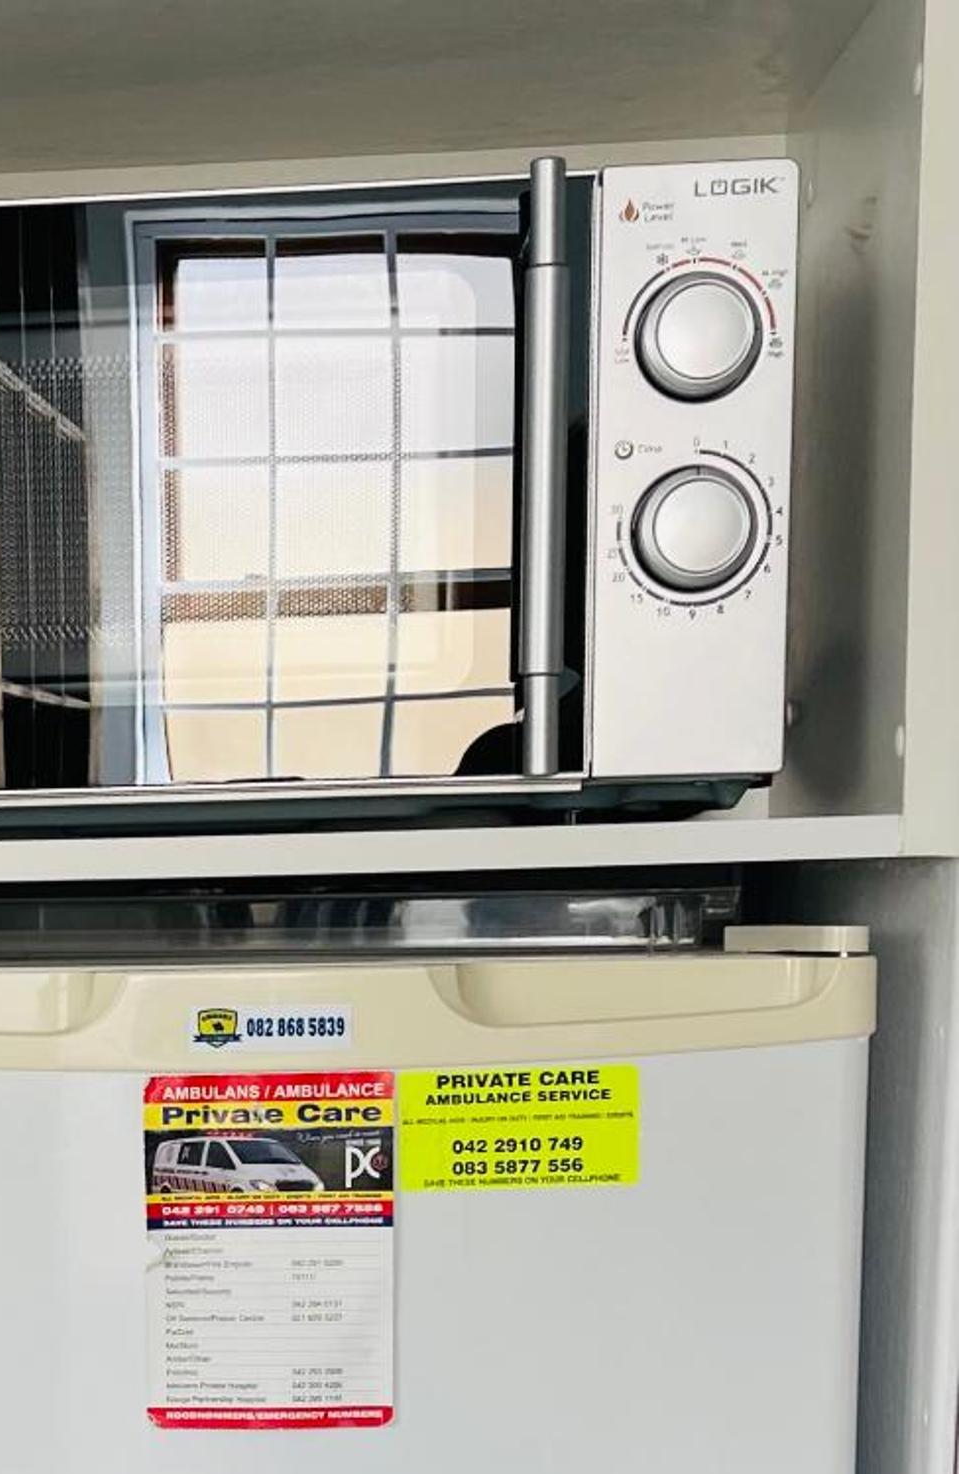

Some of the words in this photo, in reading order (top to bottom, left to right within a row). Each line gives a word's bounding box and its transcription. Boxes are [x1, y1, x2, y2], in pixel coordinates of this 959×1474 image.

[695, 177, 780, 197] LOGIK
[642, 202, 674, 211] Power
[644, 212, 673, 222] Level
[775, 506, 783, 515] 4
[775, 536, 783, 546] 5
[764, 563, 770, 573] 6
[612, 573, 625, 582] 20
[631, 594, 643, 603] 15
[745, 591, 751, 600] 7
[657, 607, 670, 616] 10
[717, 605, 724, 614] 8
[247, 1018, 273, 1037] 082
[278, 1017, 305, 1037] 868
[308, 1016, 345, 1037] 5839
[437, 1072, 531, 1089] PRIVATE
[539, 1070, 599, 1085] CARE
[162, 1084, 260, 1100] AMBULANS
[274, 1082, 385, 1098] AMBULANCE
[425, 1091, 531, 1106] AMBULANCE
[537, 1088, 612, 1102] SERVICE
[297, 1104, 382, 1123] Care
[453, 1140, 487, 1154] 042
[494, 1138, 541, 1152] 2910
[549, 1136, 583, 1151] 749
[452, 1161, 487, 1175] 083
[494, 1159, 541, 1174] 5877
[548, 1157, 583, 1172] 556
[424, 1179, 445, 1188] SAVE
[449, 1178, 475, 1187] THESE
[479, 1177, 522, 1186] NUMBERS
[525, 1176, 538, 1184] ON
[540, 1175, 564, 1184] YOUR
[567, 1173, 621, 1183] CELLPHONE
